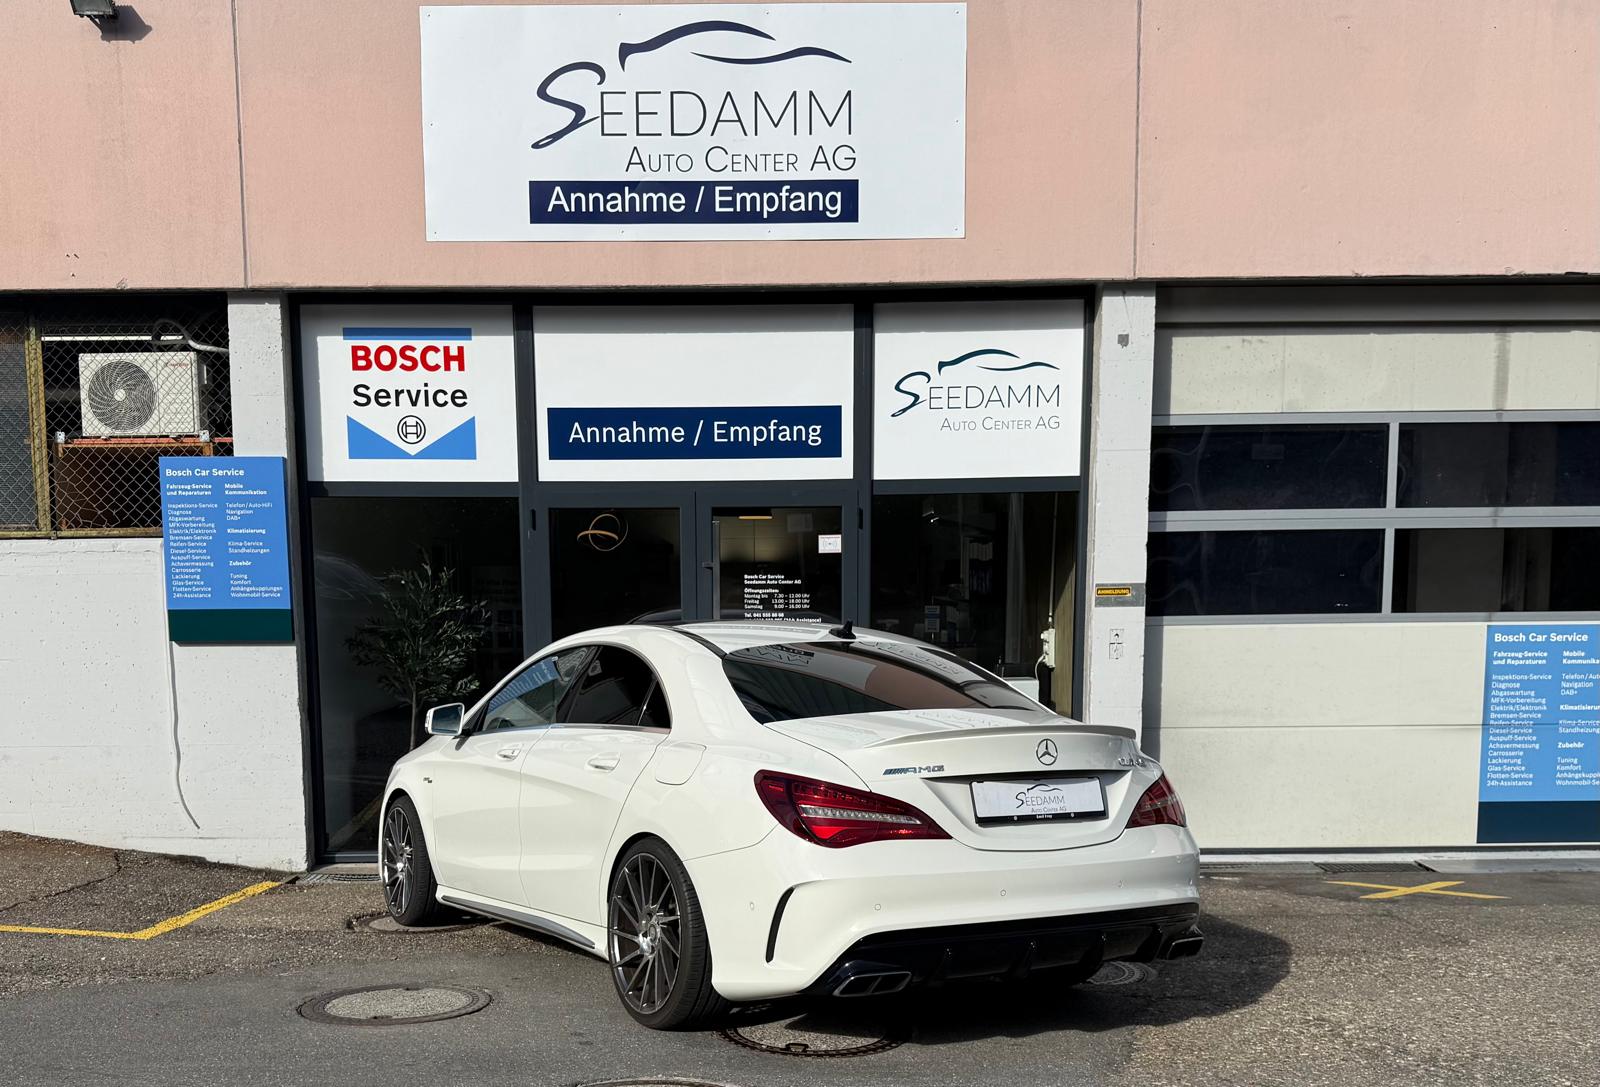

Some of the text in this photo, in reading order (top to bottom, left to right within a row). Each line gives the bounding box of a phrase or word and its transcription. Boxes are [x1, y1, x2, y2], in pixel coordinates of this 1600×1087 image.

[530, 61, 852, 150] SEEDAMM
[810, 144, 856, 172] AG
[547, 186, 842, 218] Annahme / Empfang
[351, 344, 465, 372] BOSCH
[352, 382, 468, 408] Service
[890, 371, 1060, 418] SEEDAMM
[568, 420, 822, 446] Annahme / Empfang
[1035, 416, 1060, 430] AG
[166, 468, 192, 476] Bosch
[212, 468, 245, 476] Service
[1494, 632, 1588, 642] Bosch Car Service
[902, 765, 944, 774] AMG
[1016, 792, 1064, 808] SEEDAMM
